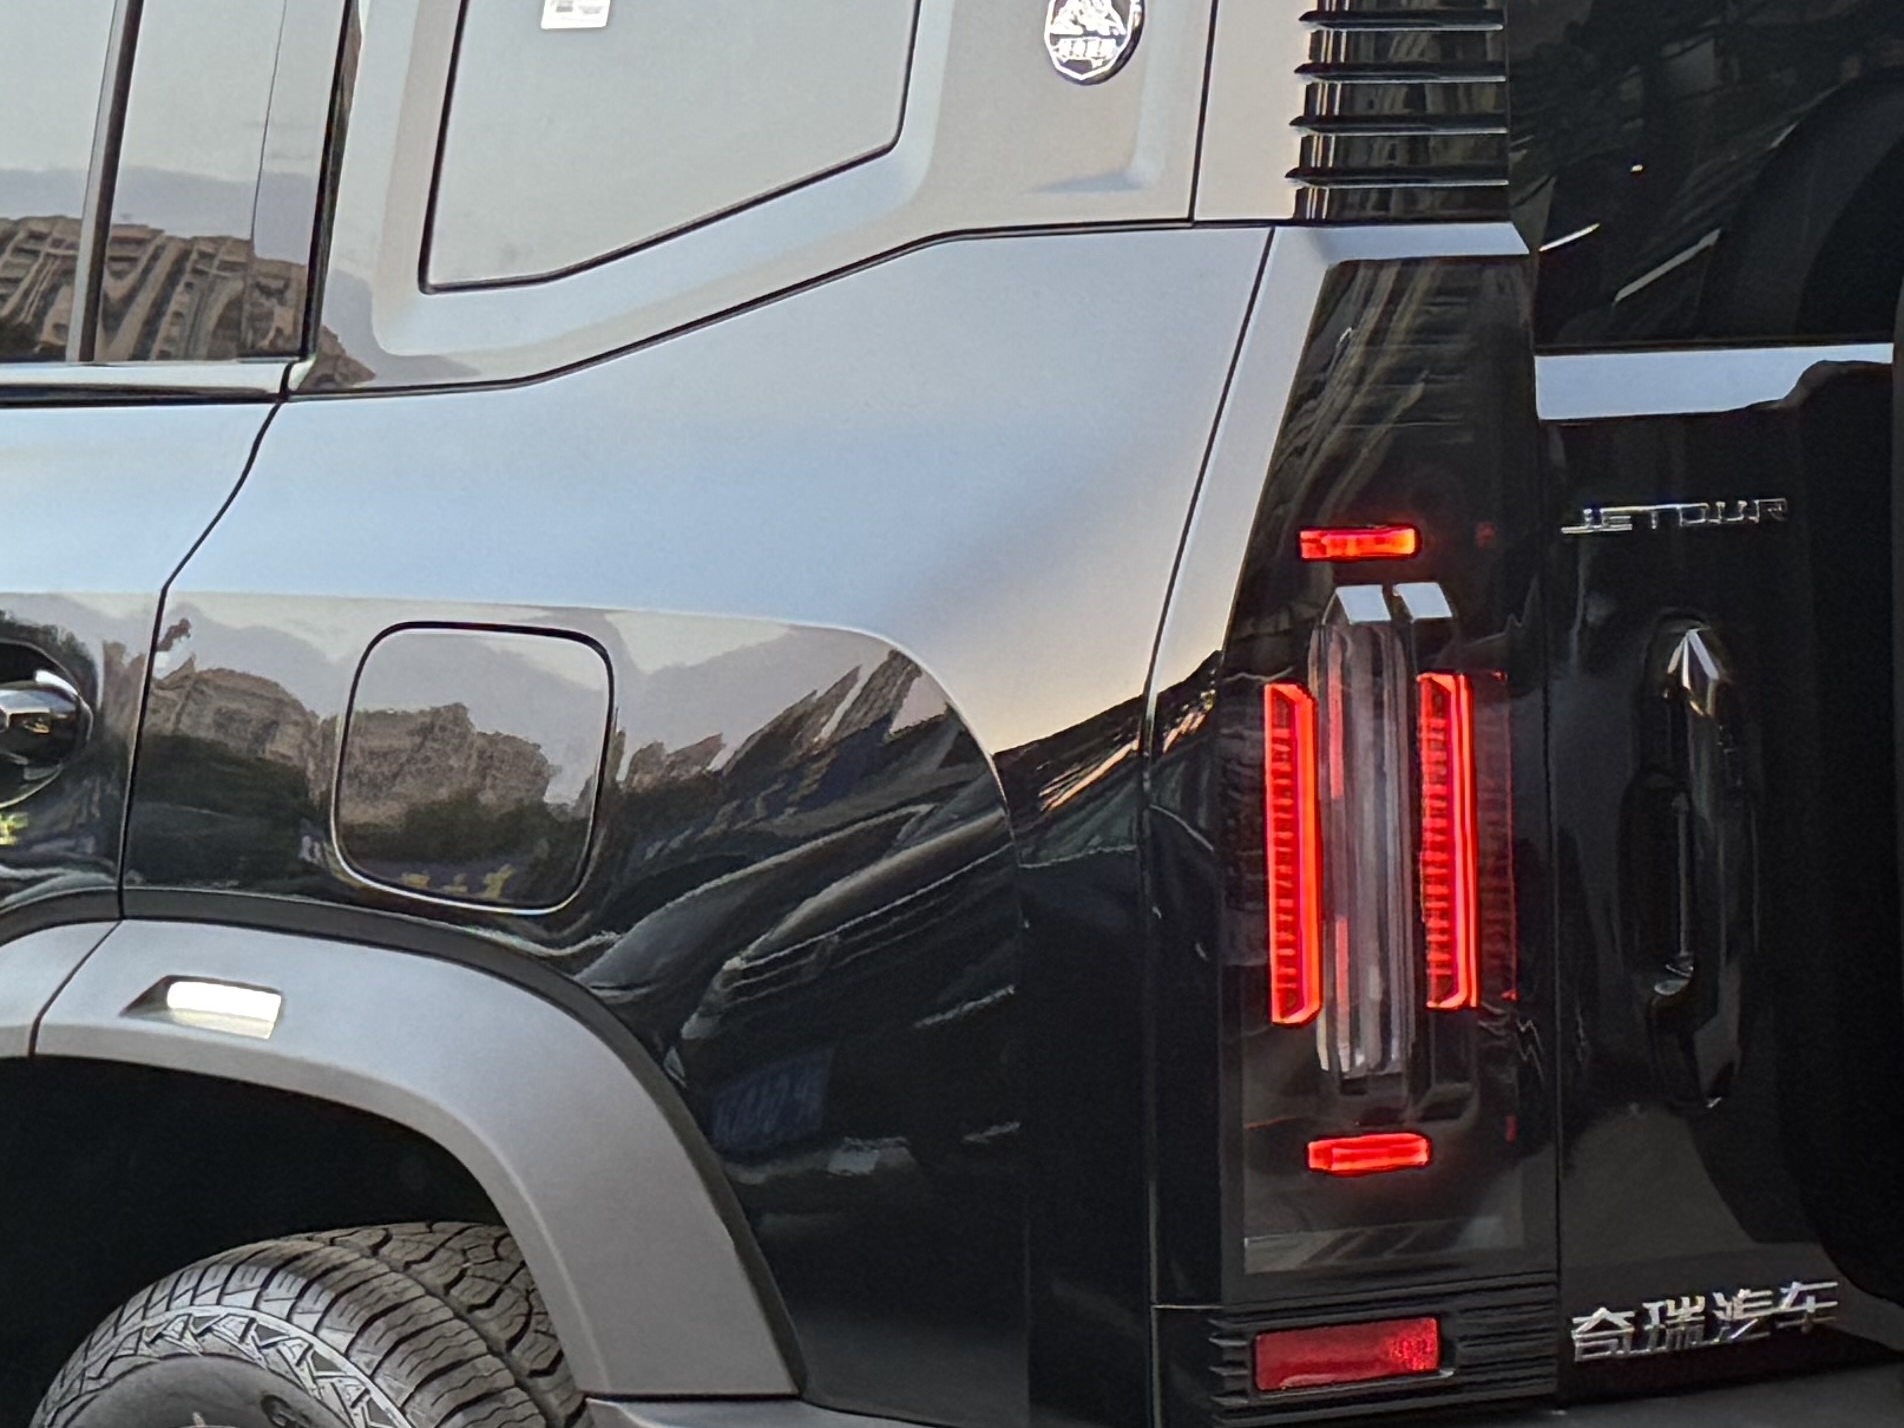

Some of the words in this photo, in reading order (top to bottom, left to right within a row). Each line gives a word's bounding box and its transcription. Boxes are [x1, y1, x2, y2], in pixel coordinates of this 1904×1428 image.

[1560, 497, 1789, 535] JETOUR
[1571, 1279, 1840, 1363] 奇瑞汽车
